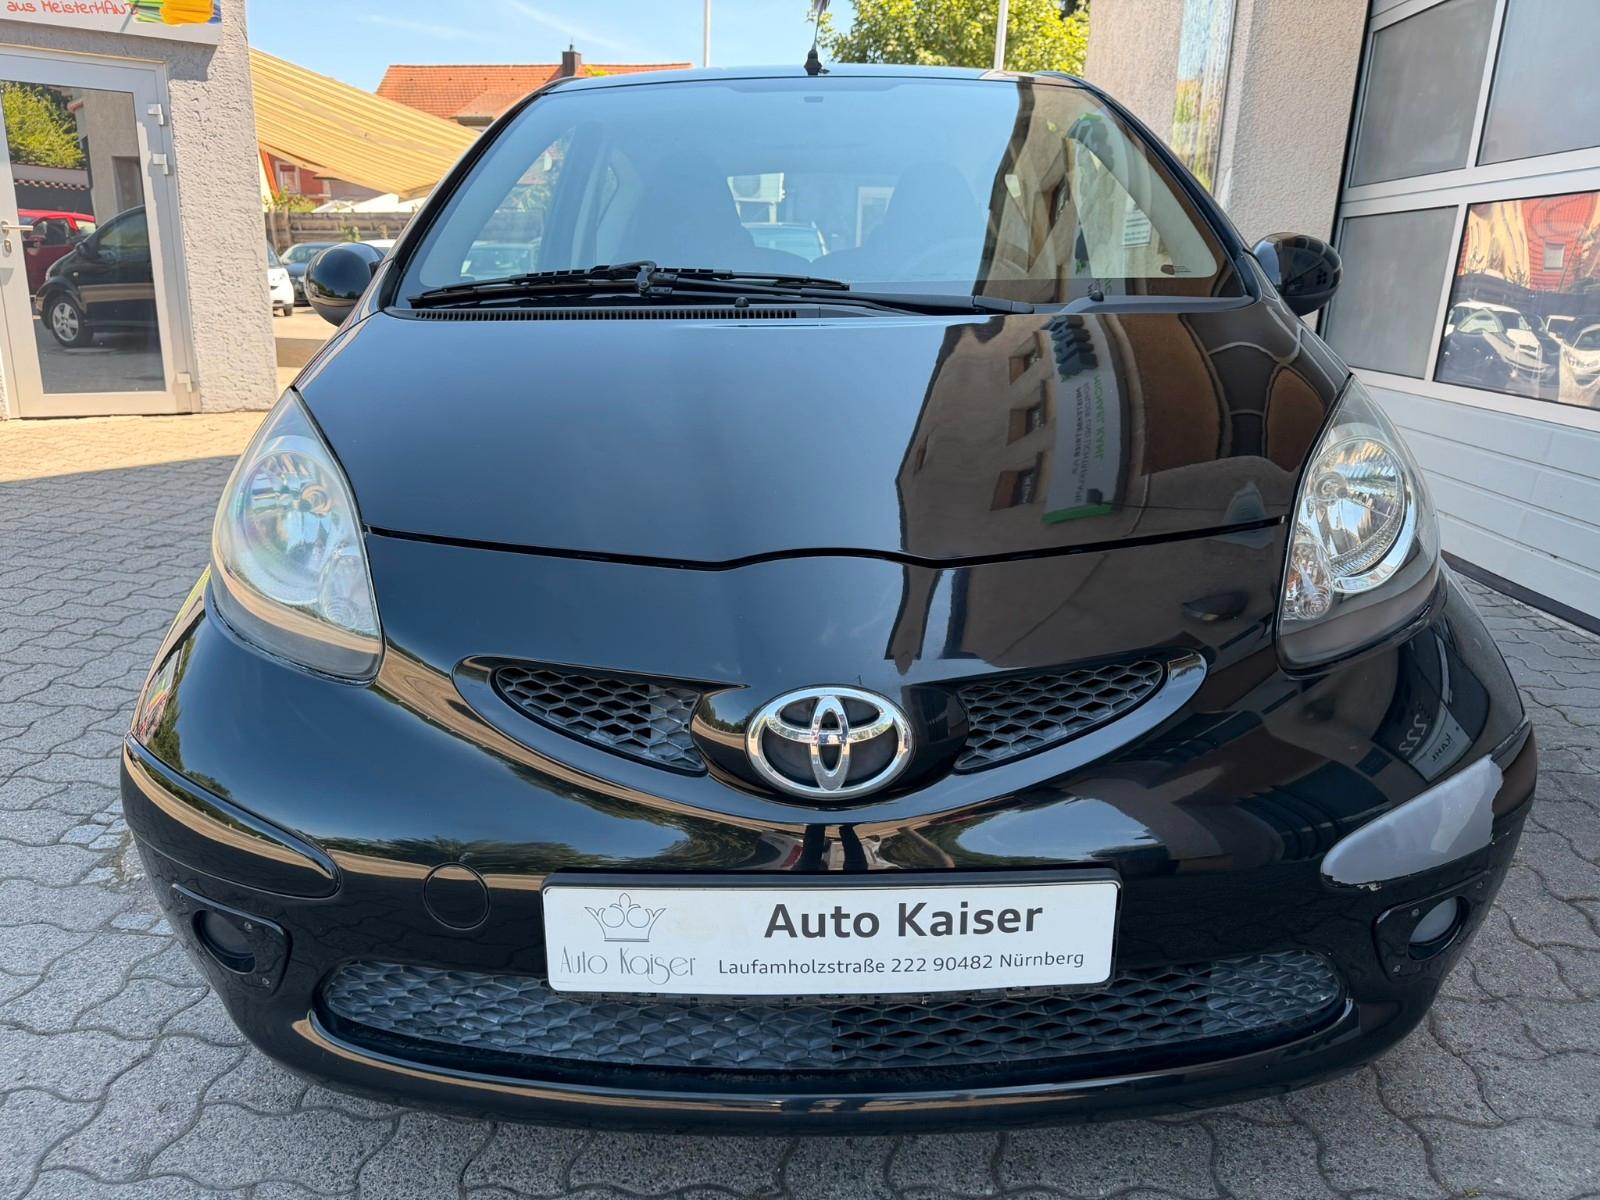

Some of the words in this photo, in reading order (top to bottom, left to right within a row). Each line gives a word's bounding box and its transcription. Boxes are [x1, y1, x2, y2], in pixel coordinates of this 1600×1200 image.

[7, 1, 36, 13] aus
[764, 903, 880, 938] Auto
[898, 901, 1043, 937] Kaiser
[560, 945, 608, 975] Auto
[620, 947, 696, 985] Kaiser
[719, 958, 885, 974] Laufamholzstraße
[891, 957, 927, 973] 222
[933, 955, 993, 972] 90482
[1000, 951, 1084, 968] Nürnberg
